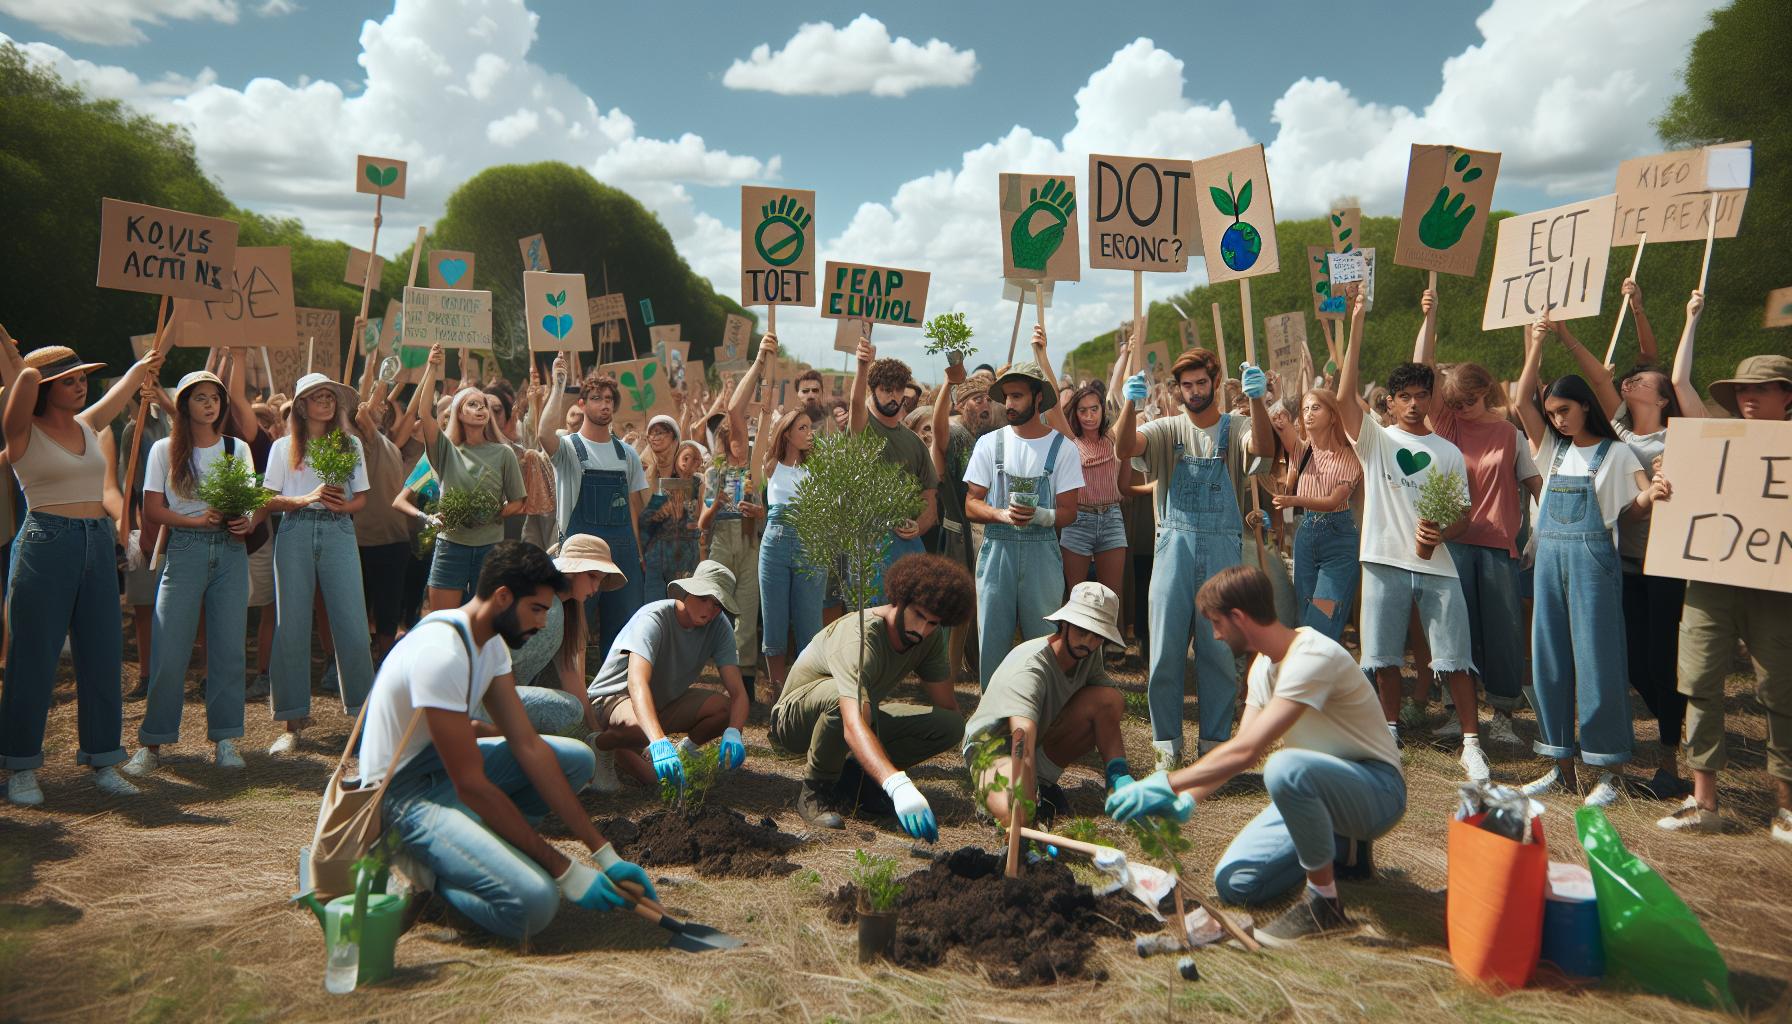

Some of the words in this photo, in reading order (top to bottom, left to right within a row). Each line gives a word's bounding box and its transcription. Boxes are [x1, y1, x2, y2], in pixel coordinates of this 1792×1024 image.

[1096, 160, 1191, 235] DOT
[1529, 208, 1590, 267] ECT
[745, 268, 809, 303] TOET
